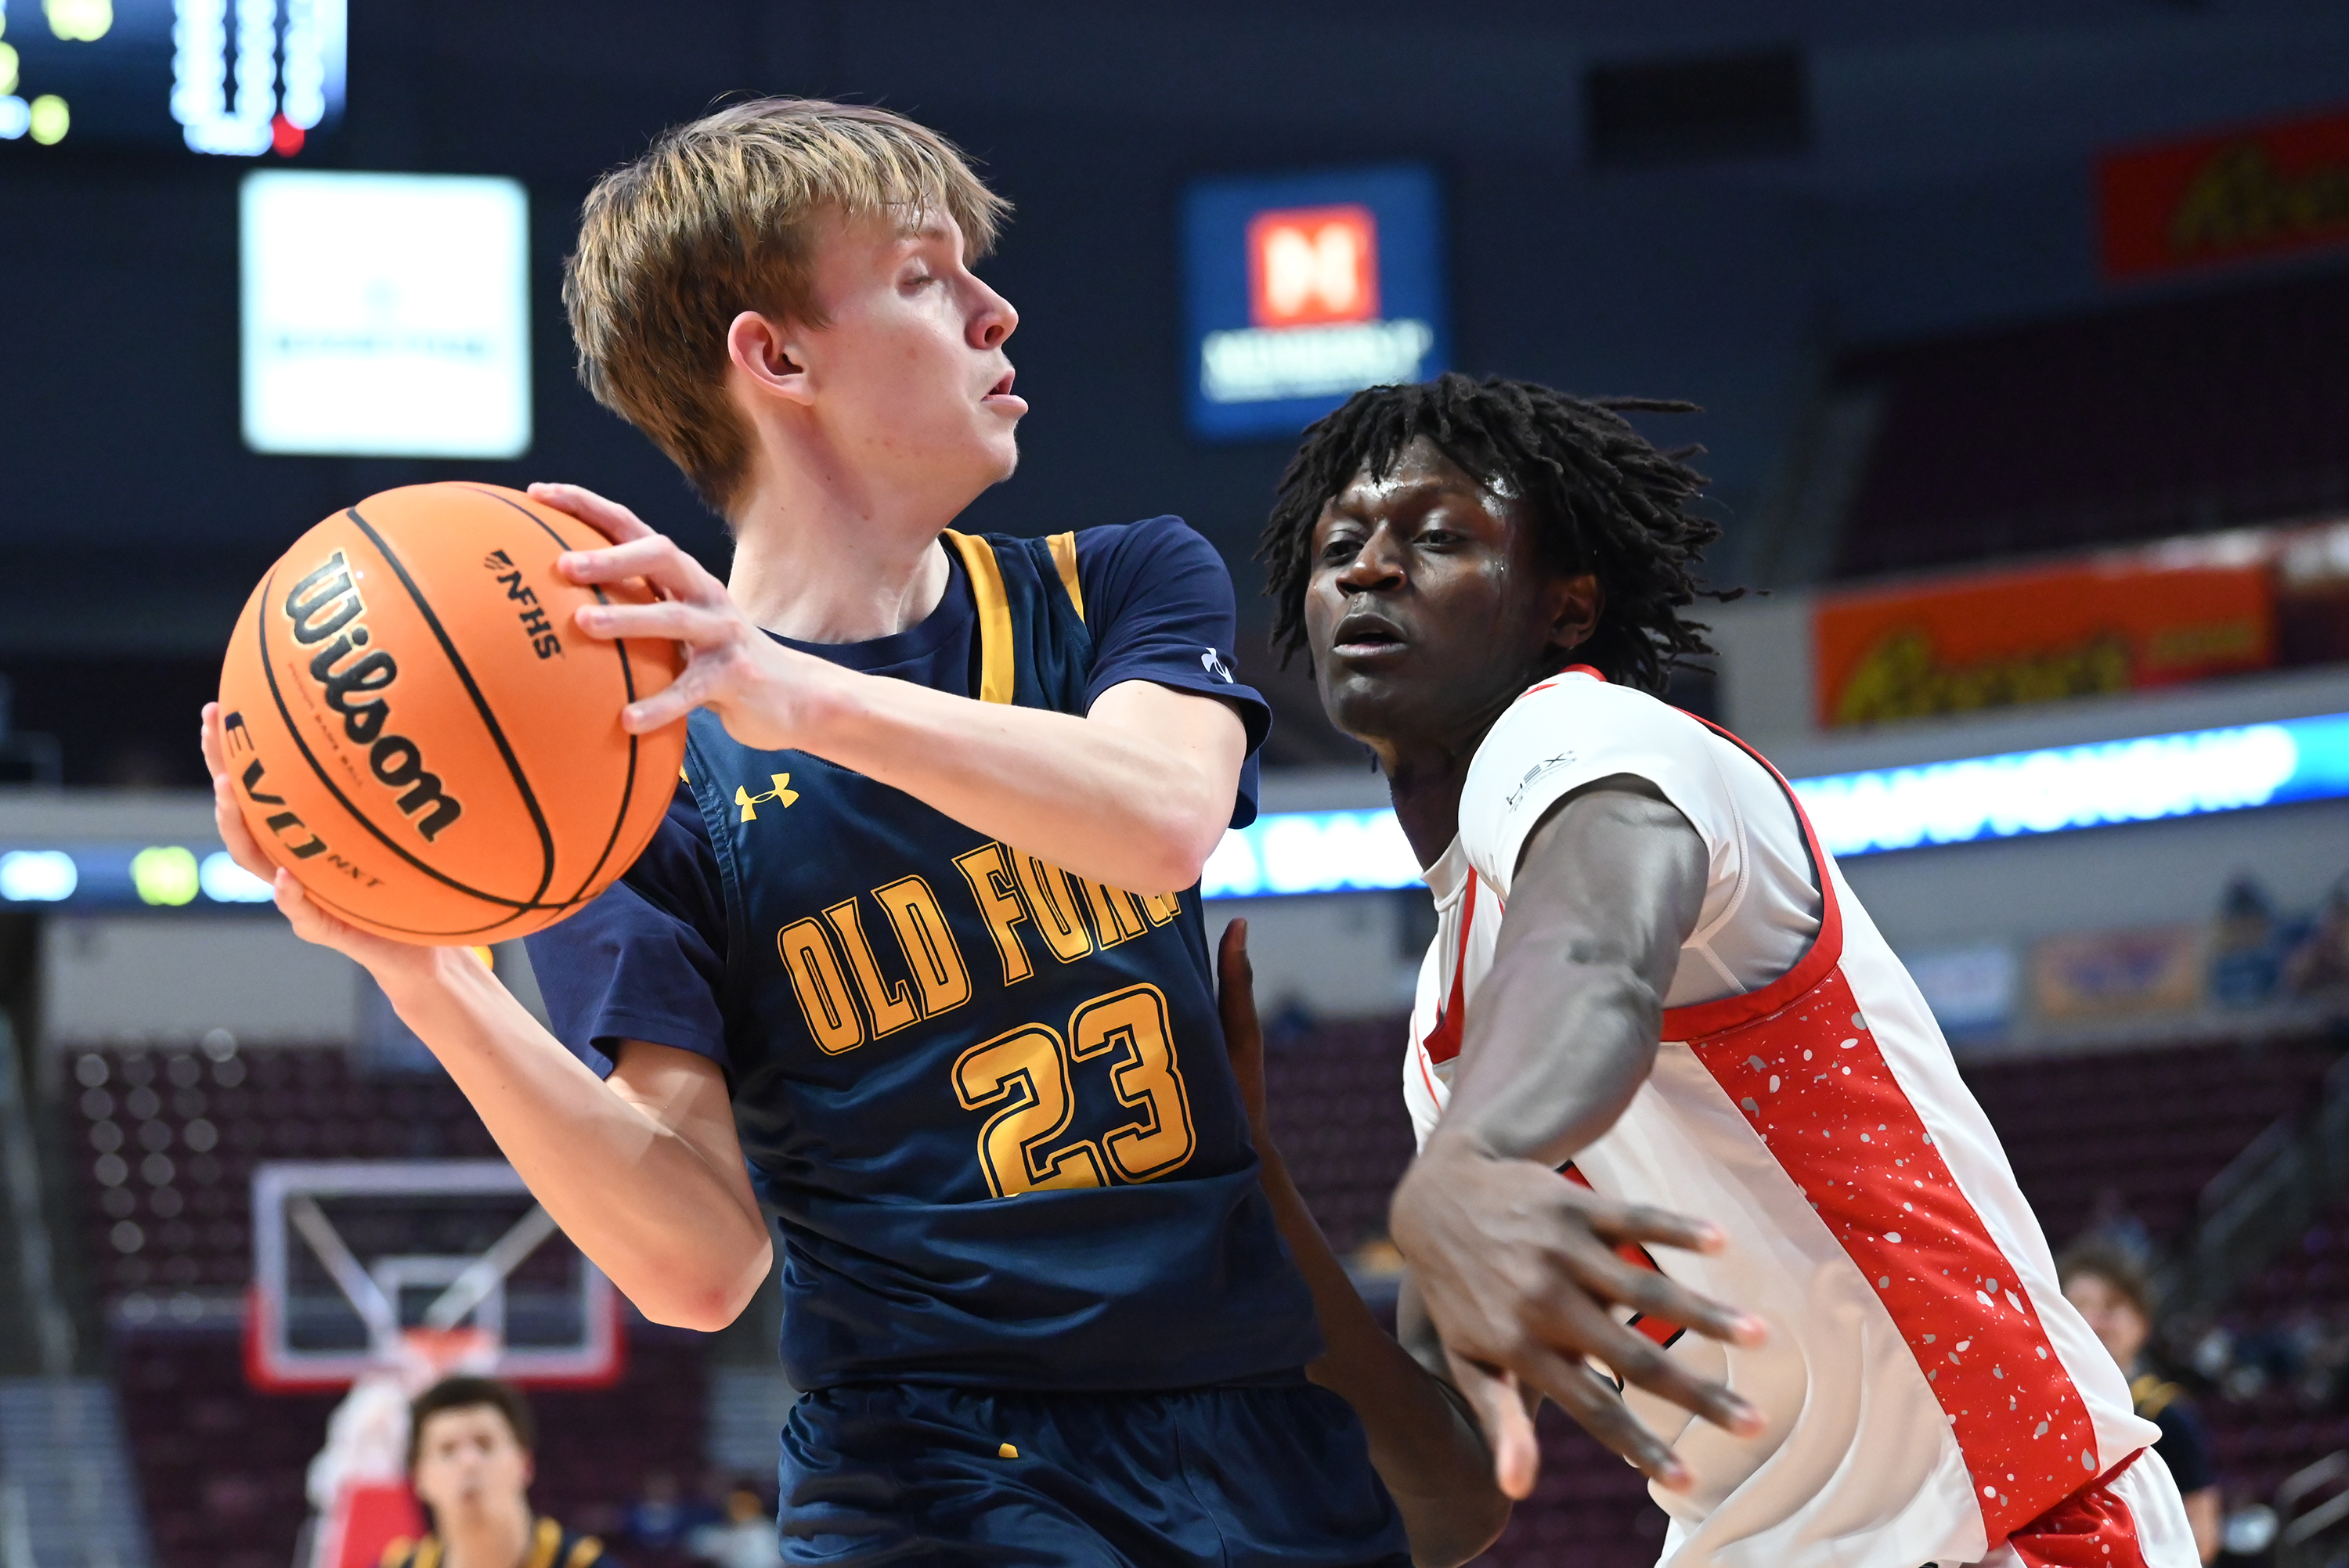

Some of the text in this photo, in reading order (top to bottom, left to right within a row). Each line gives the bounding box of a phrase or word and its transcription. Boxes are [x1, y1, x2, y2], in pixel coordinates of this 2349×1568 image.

[282, 546, 463, 844] Wilson
[496, 569, 562, 660] NFHS
[224, 710, 388, 888] EVO NXT
[777, 874, 972, 1056] OLD
[951, 982, 1196, 1200] 23
